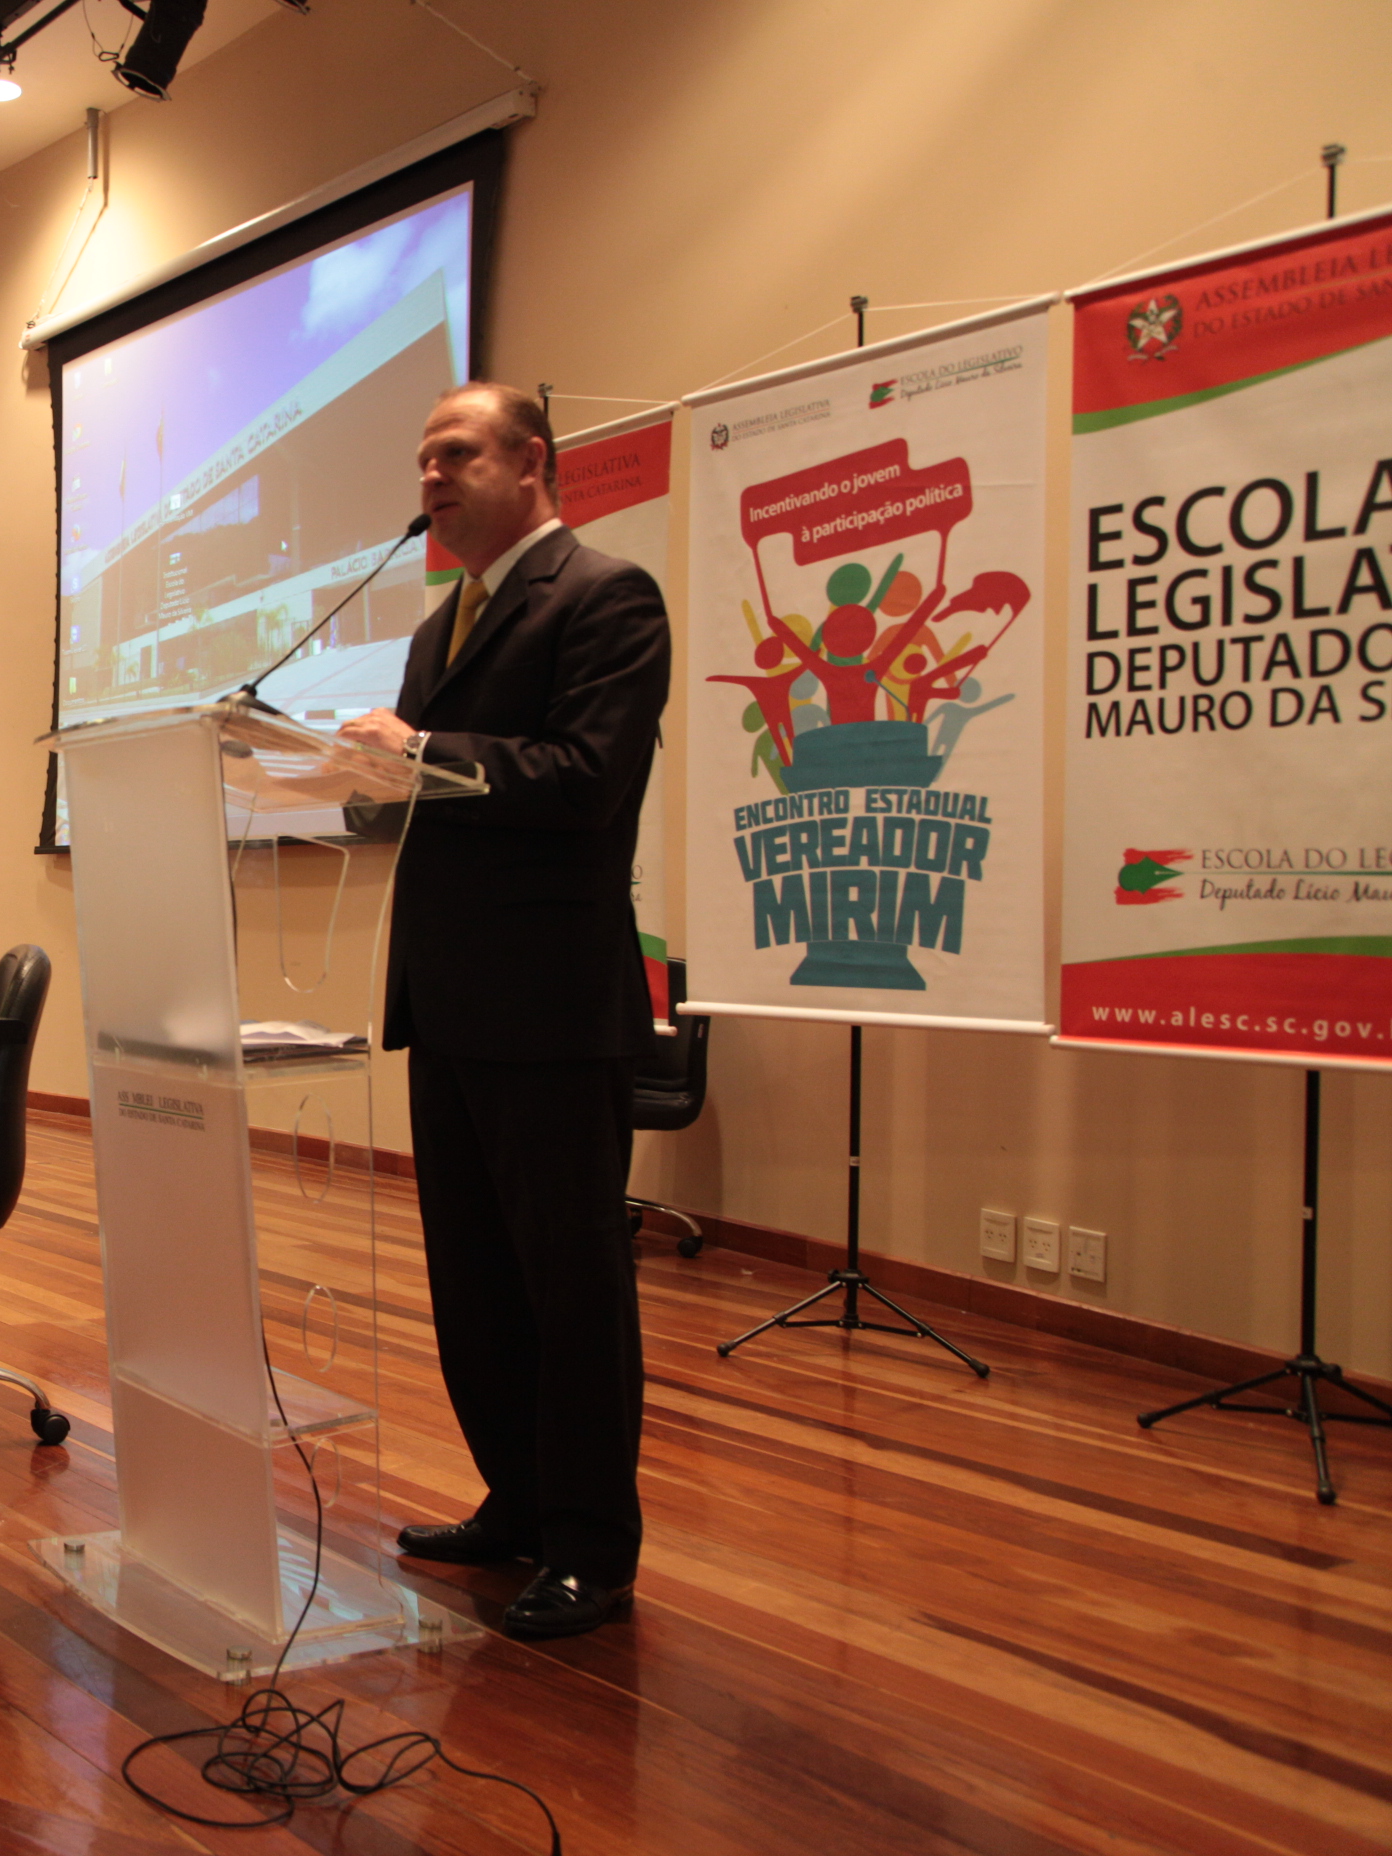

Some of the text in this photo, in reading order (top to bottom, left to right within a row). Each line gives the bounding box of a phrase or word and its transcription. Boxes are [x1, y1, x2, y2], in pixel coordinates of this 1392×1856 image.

[1195, 254, 1358, 311] ASSEMBLEIA
[1193, 316, 1224, 339] DO
[1231, 297, 1313, 330] ESTADO
[1319, 289, 1346, 309] DE
[749, 464, 901, 523] Incentivando o jovem
[801, 483, 964, 544] à participação política
[1088, 458, 1392, 573] ESCOLA
[1086, 547, 1392, 642] LEGISLA
[1085, 622, 1392, 696] DEPUTADO
[1084, 680, 1392, 739] MAURO DA S
[733, 788, 992, 832] ENCONTRO ESTADUAL
[733, 816, 991, 883] VEREADOR
[1201, 847, 1392, 870] ESCOLA DO LE
[753, 869, 966, 955] MIRIM
[1199, 877, 1286, 912] Deputado
[1091, 1005, 1392, 1041] www.alesc.sc.gov.
